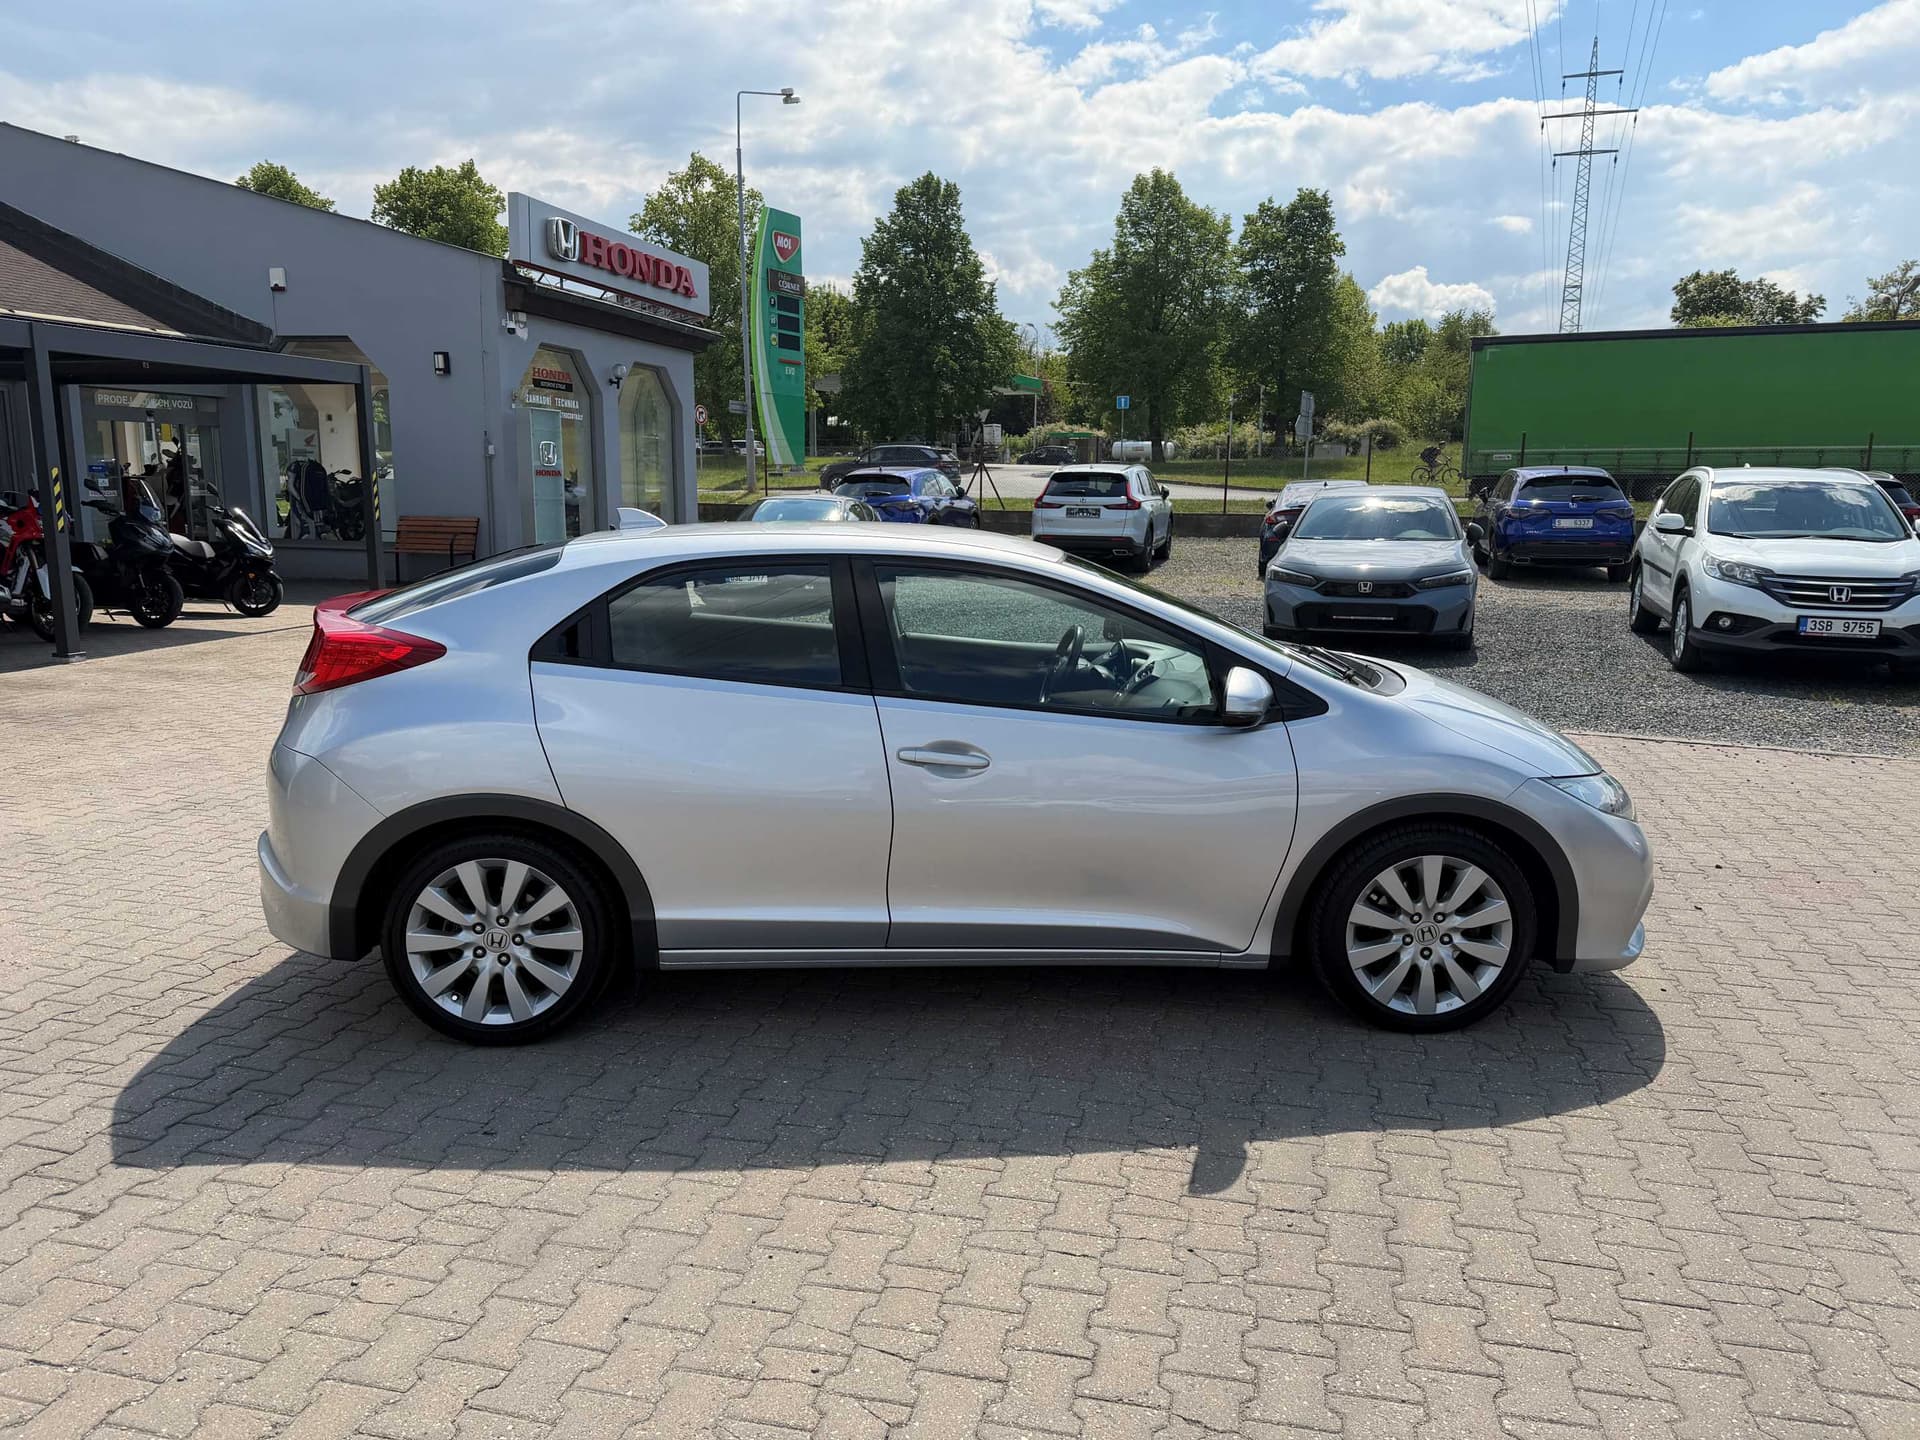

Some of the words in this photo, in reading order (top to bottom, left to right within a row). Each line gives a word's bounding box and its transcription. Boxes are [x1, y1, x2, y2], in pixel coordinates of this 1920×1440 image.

[776, 234, 792, 250] MOL
[579, 231, 698, 298] HONDA
[778, 280, 801, 292] CORNER
[533, 367, 573, 382] HONDA
[97, 393, 132, 405] PRODEJ
[172, 398, 193, 409] VOZŮ
[526, 393, 552, 406] ZAHRADNÍ
[555, 397, 579, 409] TECHNIKA
[535, 469, 562, 477] HONDA
[1809, 619, 1833, 632] 3SB
[1842, 621, 1875, 634] 9755
